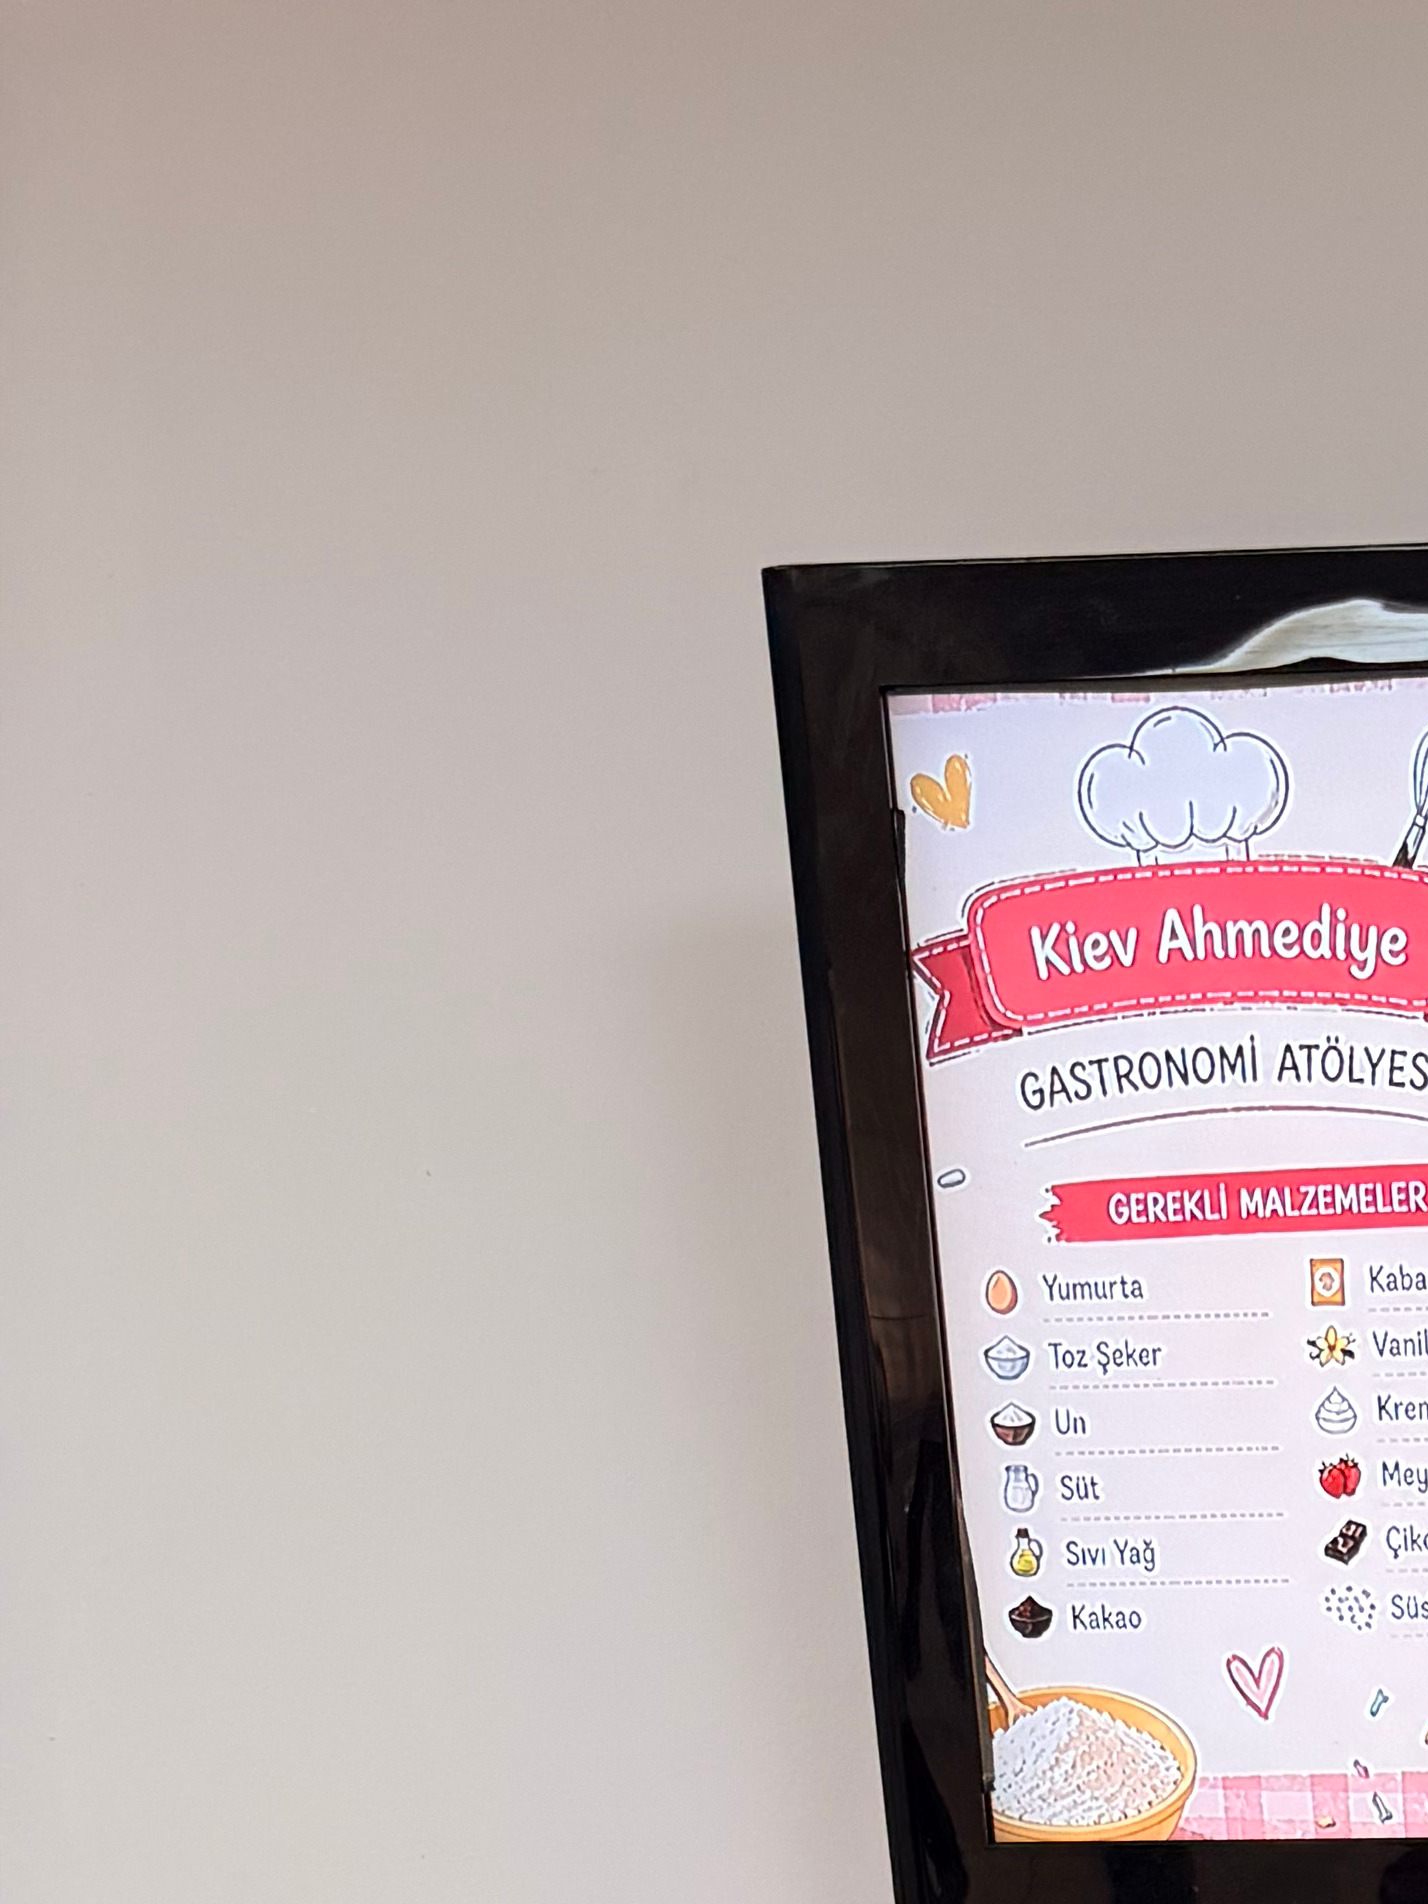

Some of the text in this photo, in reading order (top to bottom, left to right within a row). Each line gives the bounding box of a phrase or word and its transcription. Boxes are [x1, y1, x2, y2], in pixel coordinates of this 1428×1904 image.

[1029, 904, 1408, 980] Kiev Ahmediye
[1019, 1035, 1258, 1112] GASTRONOMİ
[1109, 1181, 1428, 1226] GEREKLİ MALZEMELER
[1042, 1273, 1144, 1303] Yumurta
[1048, 1342, 1162, 1376] Toz Şeker
[1054, 1409, 1087, 1435] Un
[1060, 1475, 1099, 1501] Süt
[1066, 1540, 1156, 1572] Sıvı Yağ
[1072, 1606, 1141, 1630] Kakao
